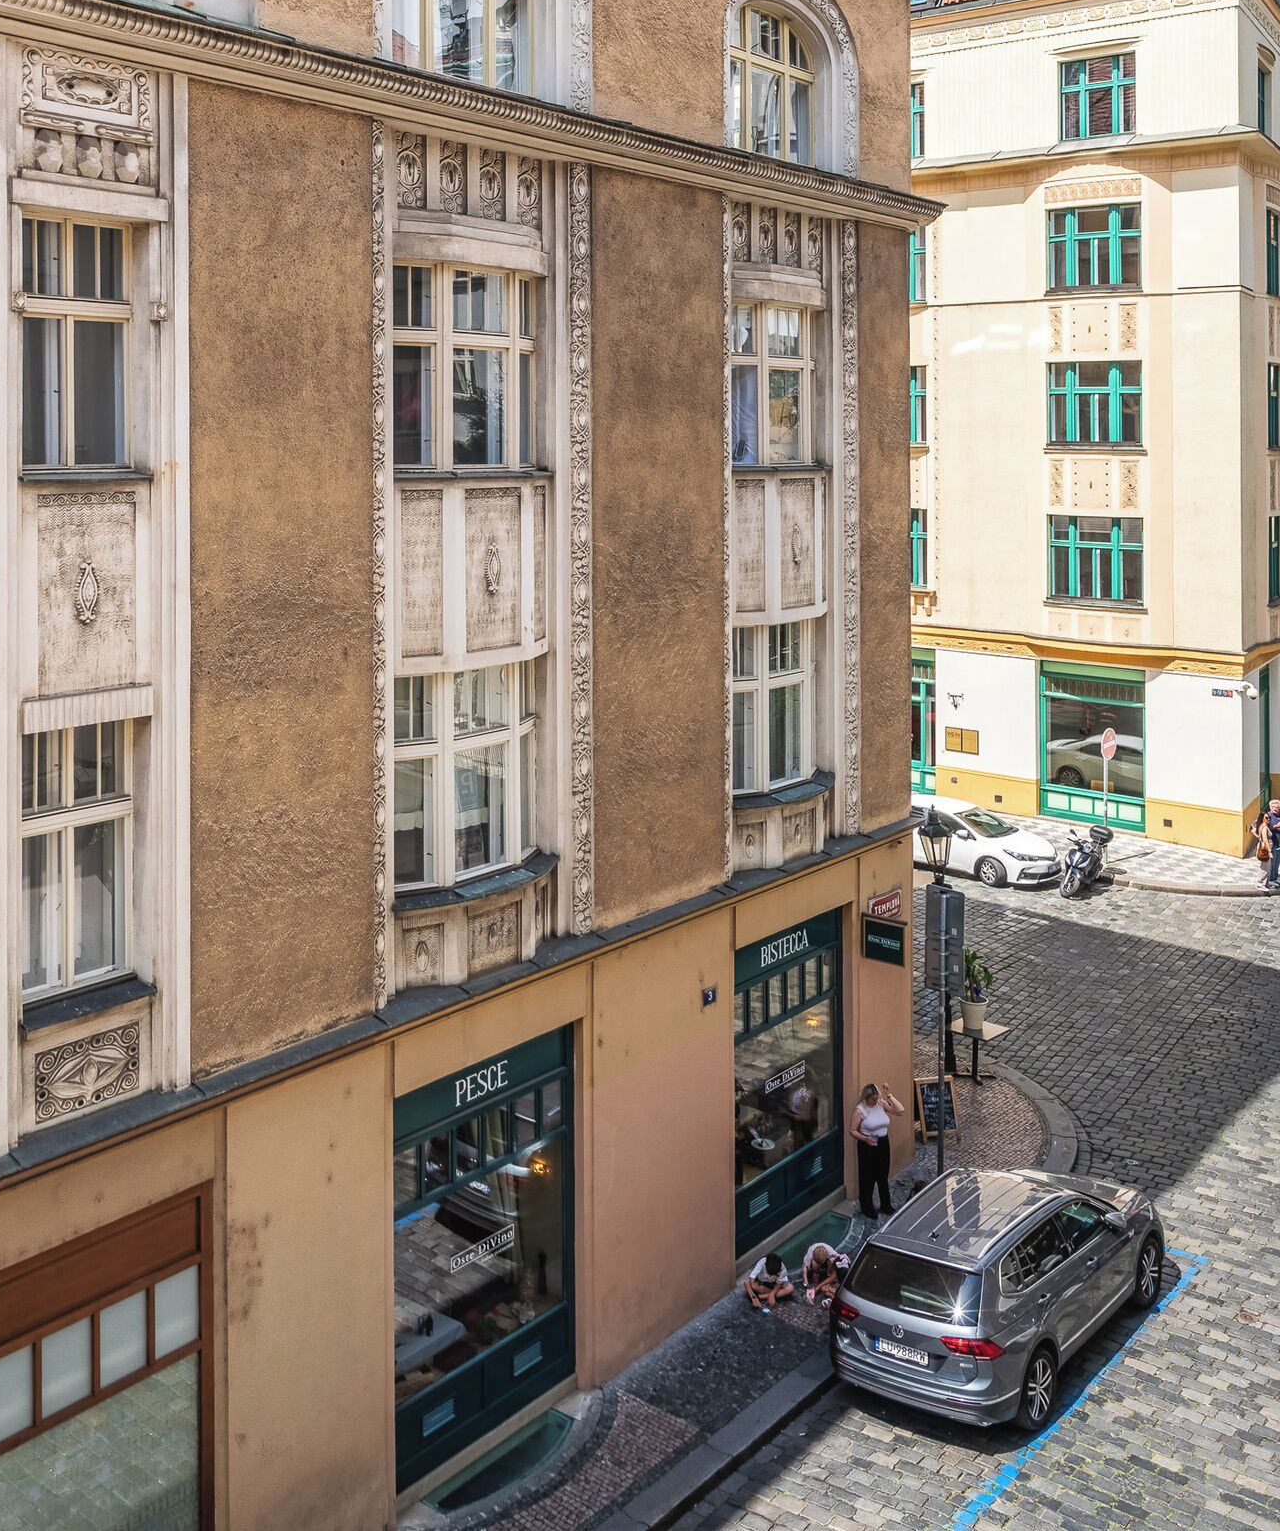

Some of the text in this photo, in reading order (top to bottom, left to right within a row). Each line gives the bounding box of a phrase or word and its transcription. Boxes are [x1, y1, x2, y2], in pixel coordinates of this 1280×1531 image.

[760, 928, 809, 968] BISTECCA
[707, 990, 713, 1001] 3
[455, 1059, 508, 1107] PESCE
[452, 1251, 475, 1269] Oste
[478, 1230, 513, 1255] DiVino
